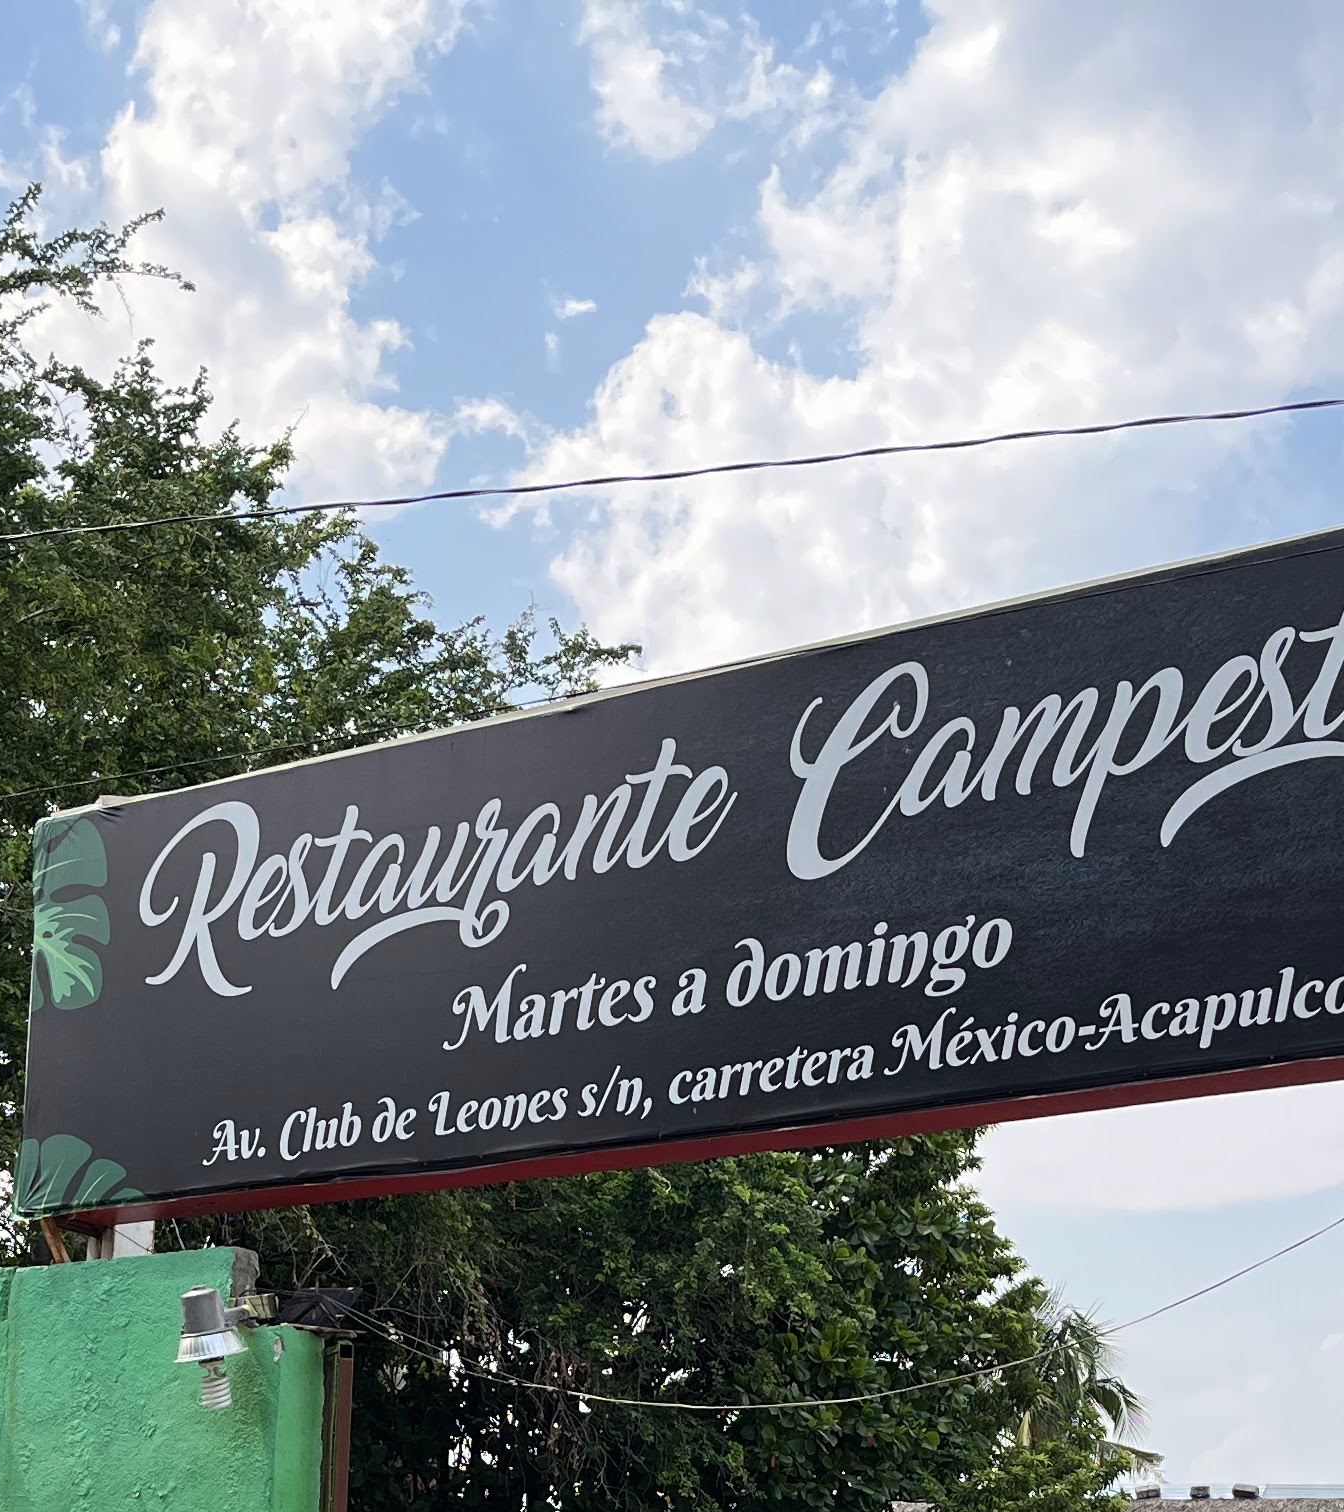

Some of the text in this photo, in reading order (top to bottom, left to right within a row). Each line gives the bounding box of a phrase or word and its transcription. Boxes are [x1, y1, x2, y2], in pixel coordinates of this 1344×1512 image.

[139, 737, 738, 997] Restaurante
[442, 913, 1013, 1051] Martes a domingo
[202, 1118, 267, 1167] Av.
[279, 1100, 361, 1160] Club
[371, 1097, 416, 1143] de
[428, 1084, 568, 1137] Leones
[577, 1064, 654, 1120] s/n,
[667, 1043, 875, 1106] carretera
